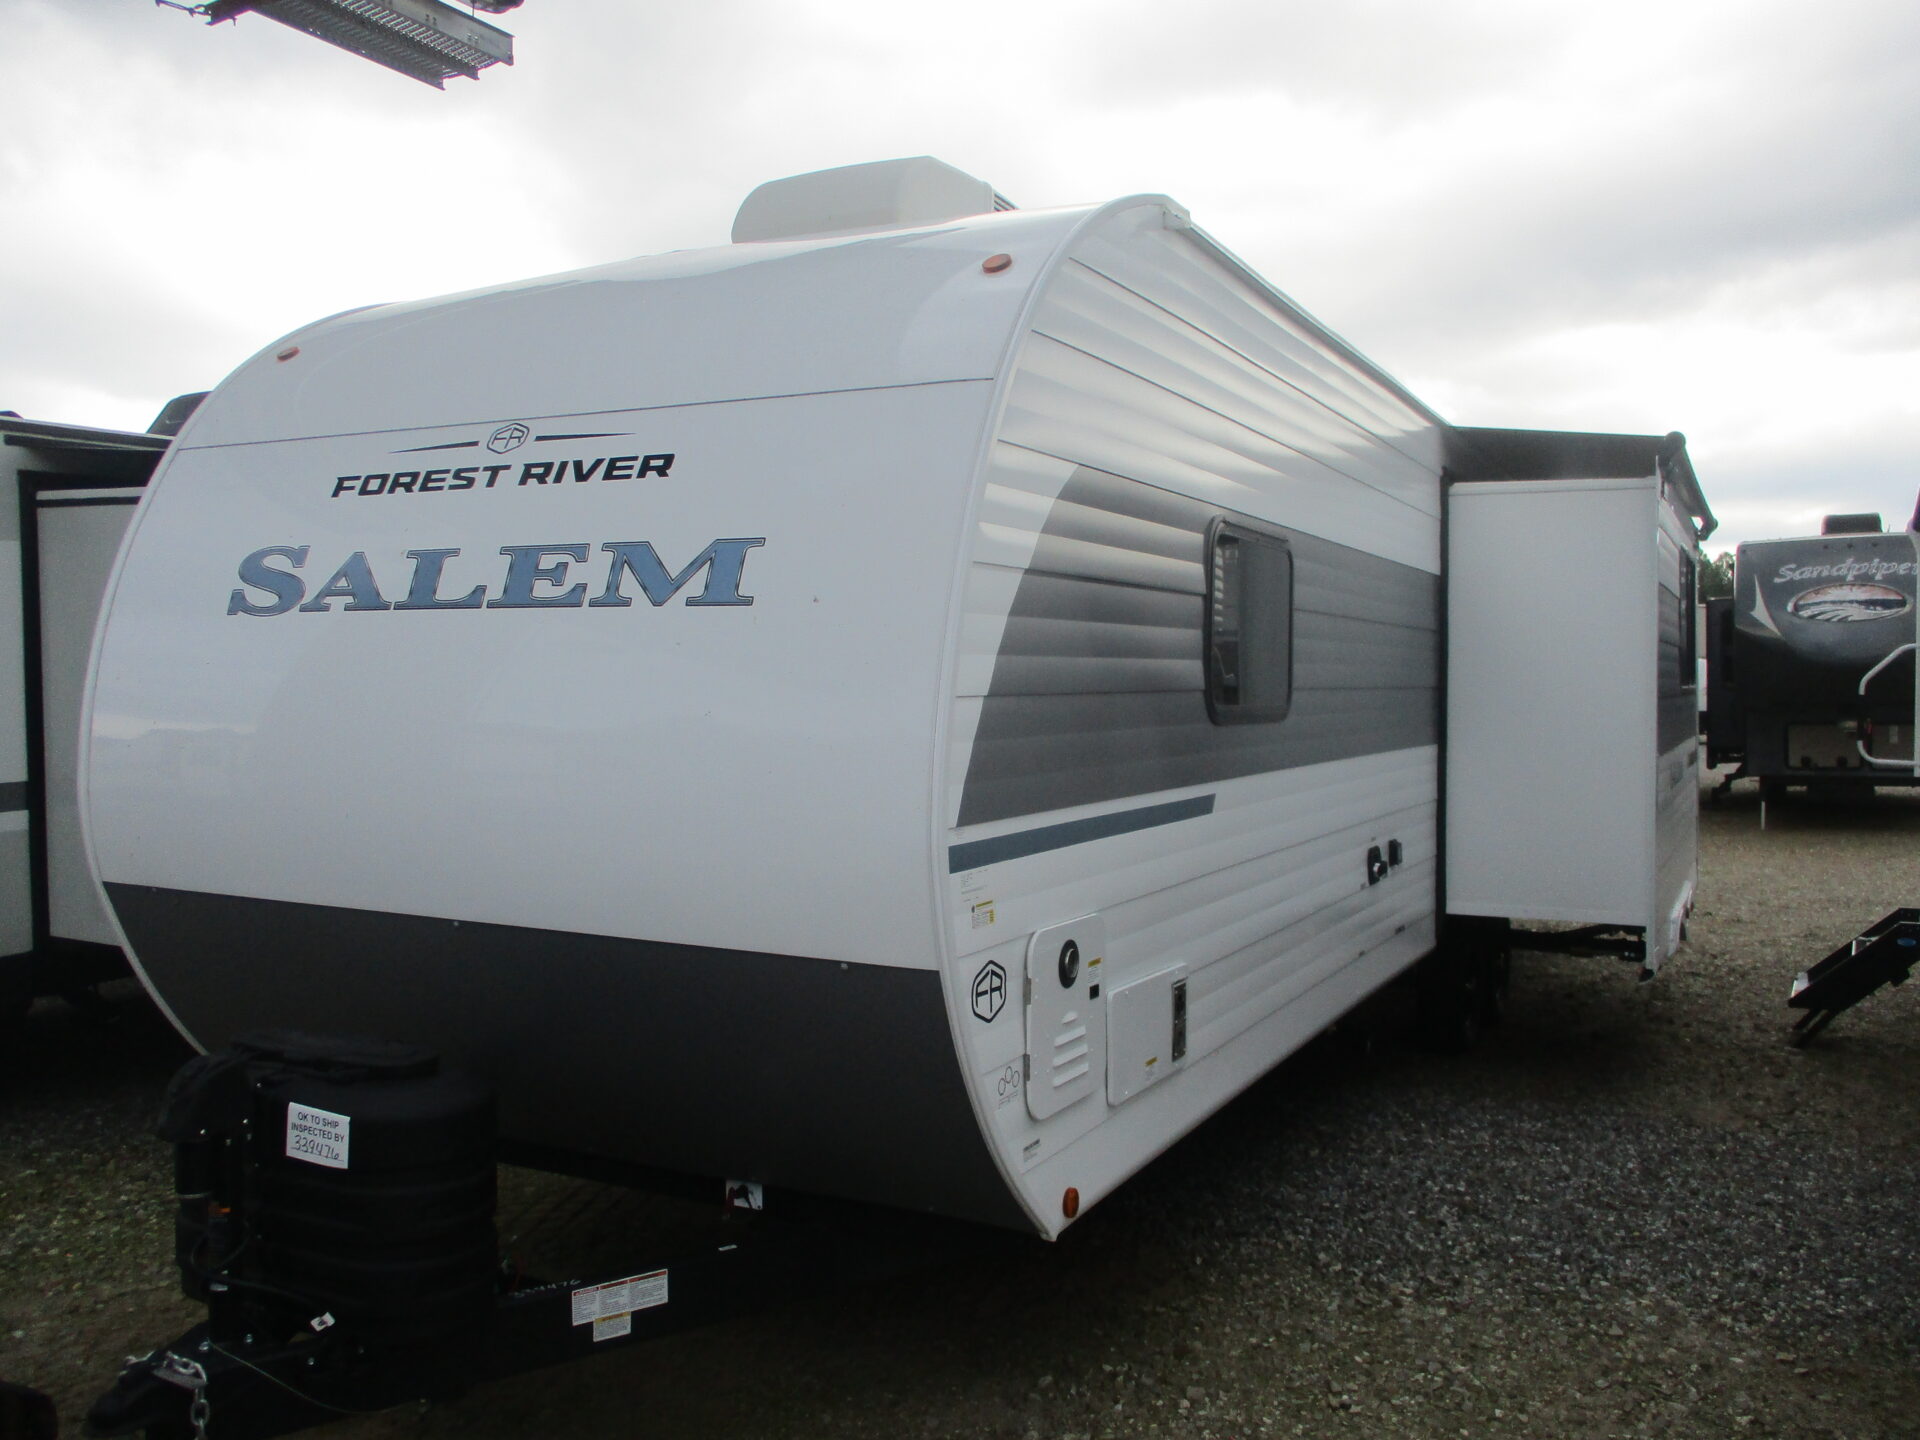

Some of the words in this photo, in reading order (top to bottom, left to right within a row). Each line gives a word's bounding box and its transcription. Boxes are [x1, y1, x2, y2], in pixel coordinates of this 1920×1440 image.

[331, 463, 511, 498] FOREST
[518, 453, 676, 486] RIVER
[226, 537, 766, 617] SALEM
[291, 1122, 333, 1140] INSPECTED
[334, 1133, 345, 1143] BY
[297, 1111, 309, 1122] OK
[310, 1114, 321, 1125] TO
[322, 1118, 340, 1129] SHIP
